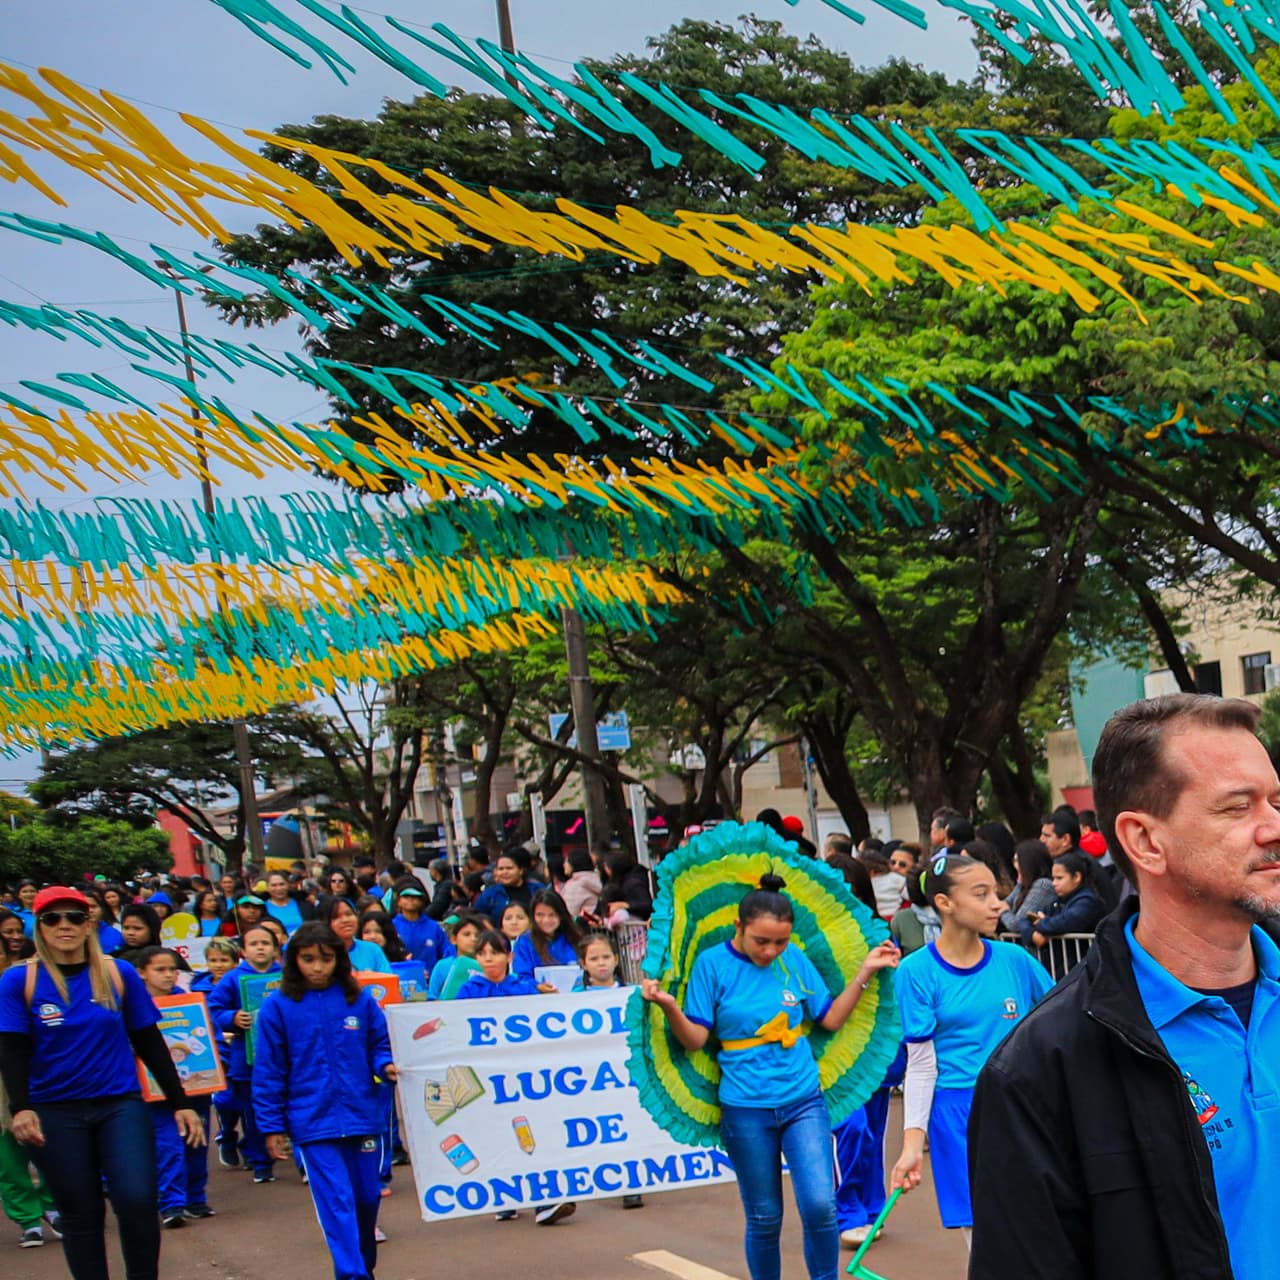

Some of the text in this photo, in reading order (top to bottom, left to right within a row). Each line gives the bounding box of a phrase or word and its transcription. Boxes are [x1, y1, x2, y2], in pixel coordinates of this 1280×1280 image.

[467, 1006, 630, 1046] ESCOL
[489, 1061, 638, 1105] LUGA
[563, 1113, 628, 1148] DE
[424, 1149, 738, 1214] CONHECIMEN
